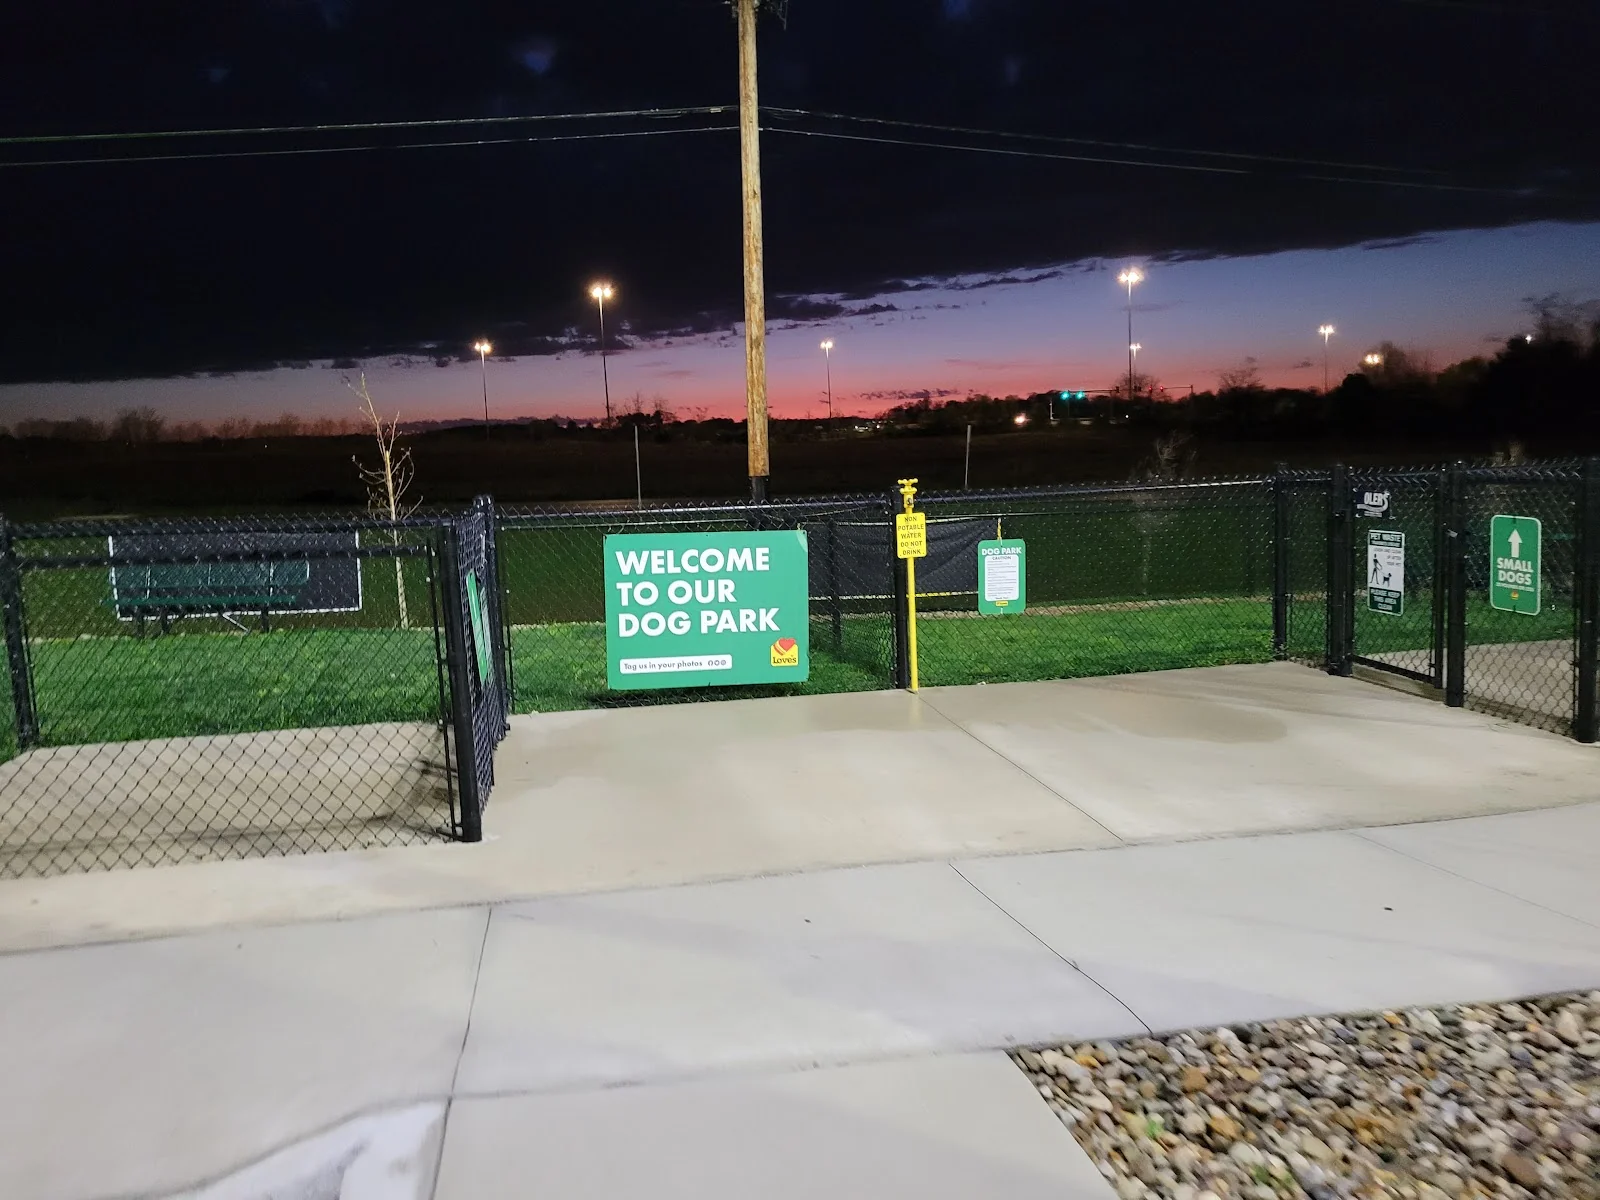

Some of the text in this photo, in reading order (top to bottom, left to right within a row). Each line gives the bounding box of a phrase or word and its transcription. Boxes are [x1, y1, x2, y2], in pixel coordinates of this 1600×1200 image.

[1381, 533, 1401, 542] WASTE
[981, 547, 1022, 556] DOG PARK
[615, 547, 770, 575] WELCOME
[1497, 557, 1534, 573] SMALL
[1498, 570, 1532, 585] DOGS
[616, 579, 737, 606] TO OUR
[618, 608, 780, 637] DOG PARK
[624, 662, 637, 671] Tag
[657, 662, 675, 670] your
[677, 660, 703, 669] photos
[773, 654, 797, 664] Love's
